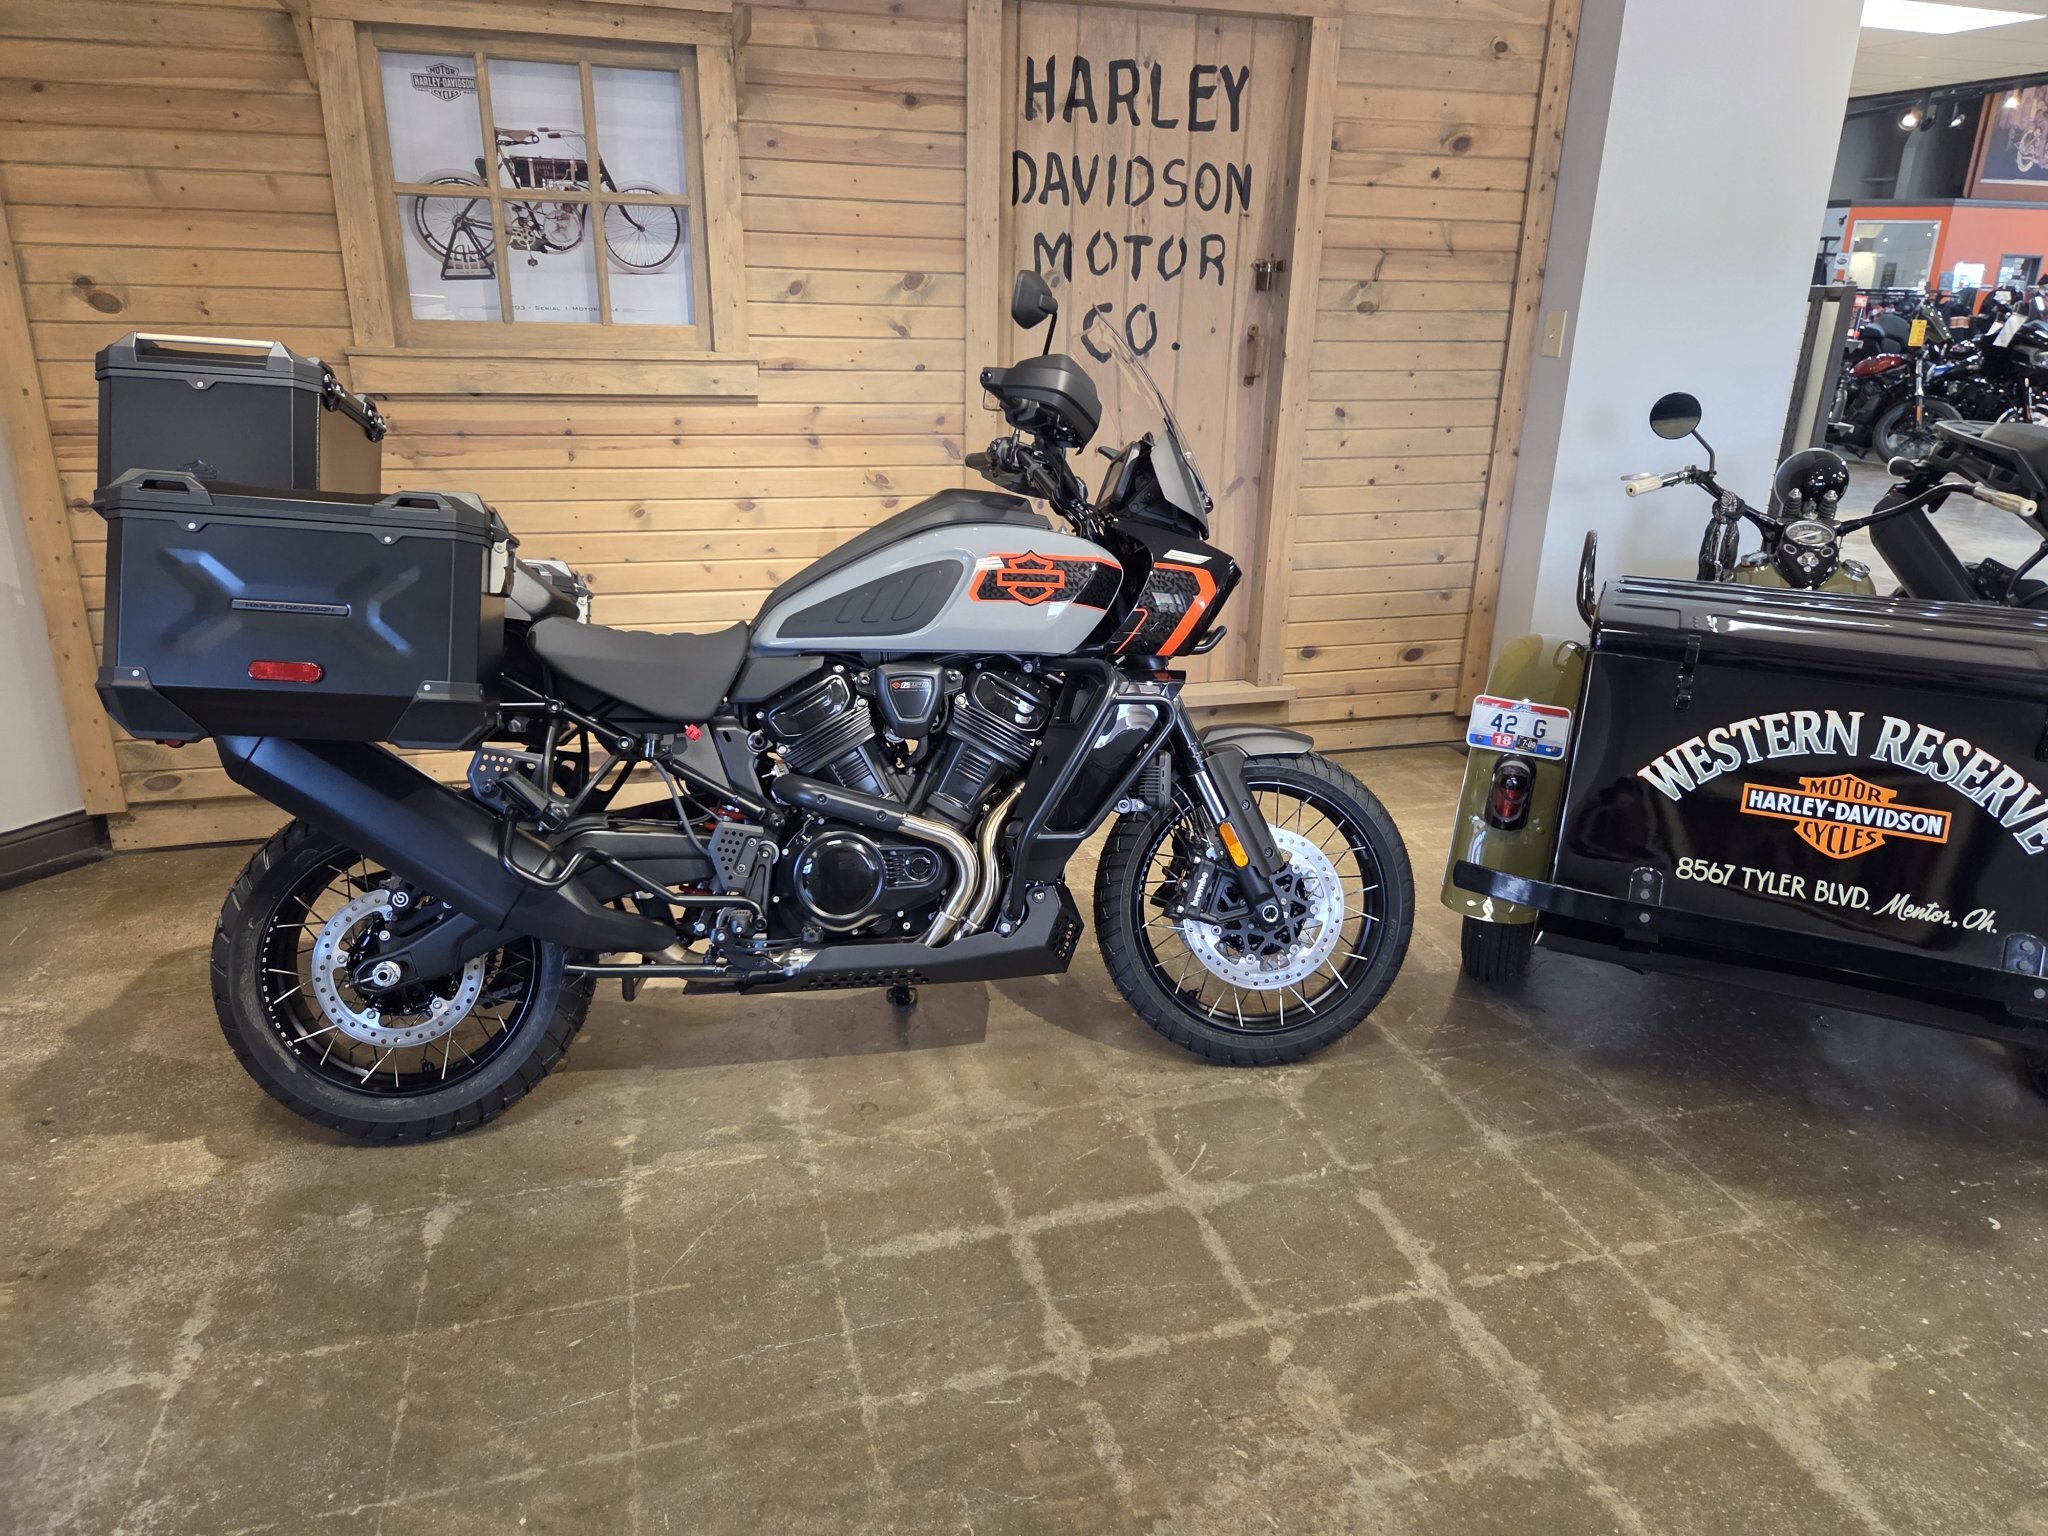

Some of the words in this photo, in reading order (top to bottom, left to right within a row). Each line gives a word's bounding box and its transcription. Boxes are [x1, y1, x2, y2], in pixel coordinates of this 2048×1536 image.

[413, 75, 475, 89] HARLEY-DAVIDSON
[429, 65, 456, 75] MOTOR
[433, 89, 459, 99] CYCLES
[1024, 54, 1250, 132] HARLEY
[1011, 150, 1252, 215] DAVIDSON
[1033, 229, 1226, 286] MOTOR
[1081, 302, 1181, 363] CO.
[1490, 713, 1518, 735] 42
[1533, 719, 1547, 738] G
[1494, 735, 1512, 746] 18
[1636, 709, 1865, 802] WESTERN
[1870, 715, 2048, 855] RESERVE
[1809, 775, 1882, 803] MOTOR
[1749, 790, 1944, 837] HARLEY-DAVIDSON
[1802, 821, 1878, 856] CYCLES
[1190, 872, 1209, 907] brembo
[1675, 856, 1736, 886] 8567
[1741, 866, 1806, 900] TYLER
[1814, 880, 1870, 910] BLVD.
[1873, 892, 1958, 928] Mentor,
[1962, 908, 1998, 934] Oh.
